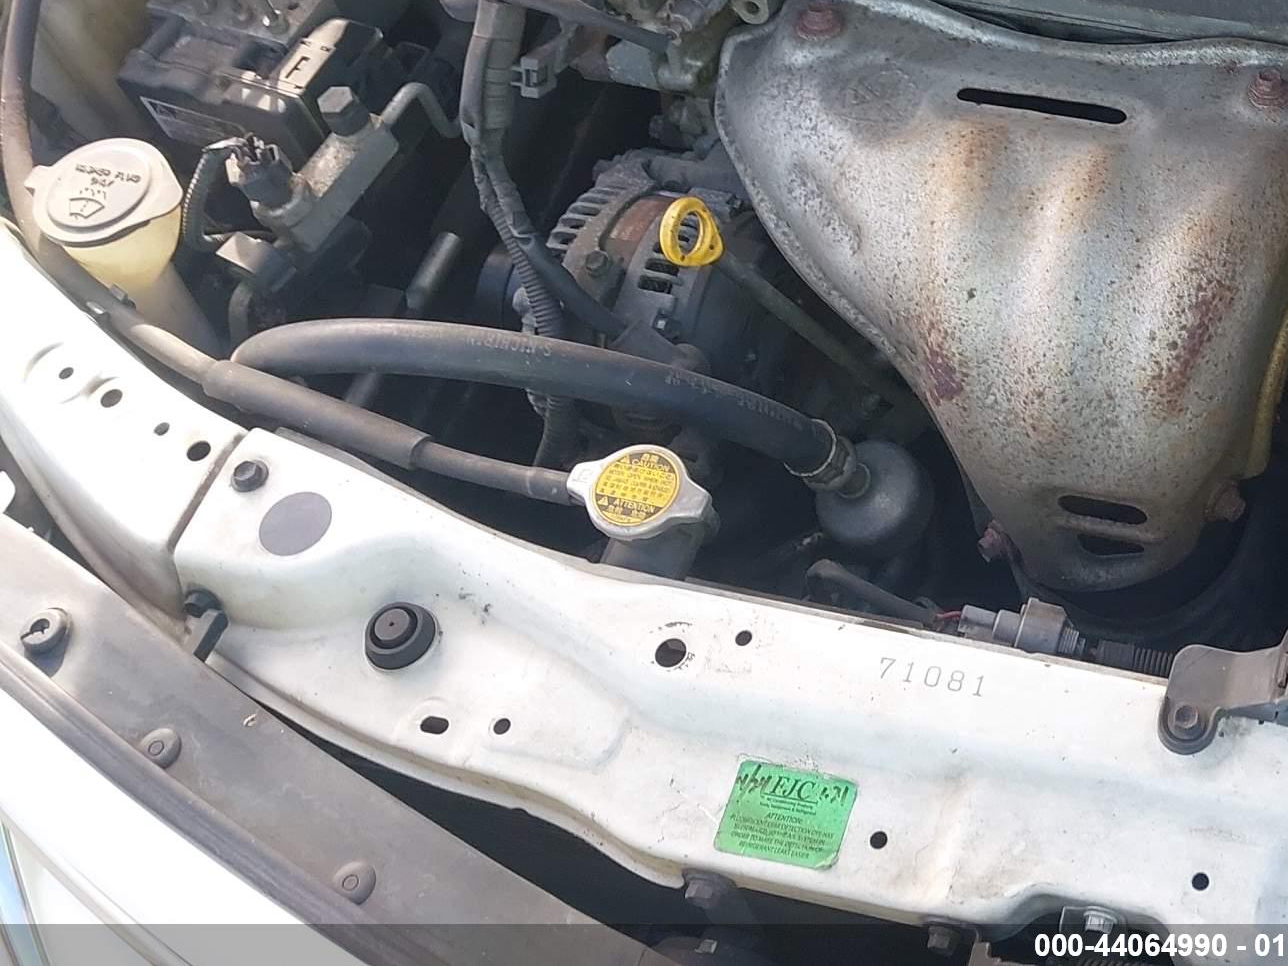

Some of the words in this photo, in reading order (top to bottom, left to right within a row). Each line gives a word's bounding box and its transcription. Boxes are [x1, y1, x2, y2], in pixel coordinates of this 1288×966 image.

[631, 458, 670, 471] CAUTION
[613, 498, 656, 513] ATTENTION
[879, 657, 985, 698] 71081
[770, 776, 814, 801] FJC
